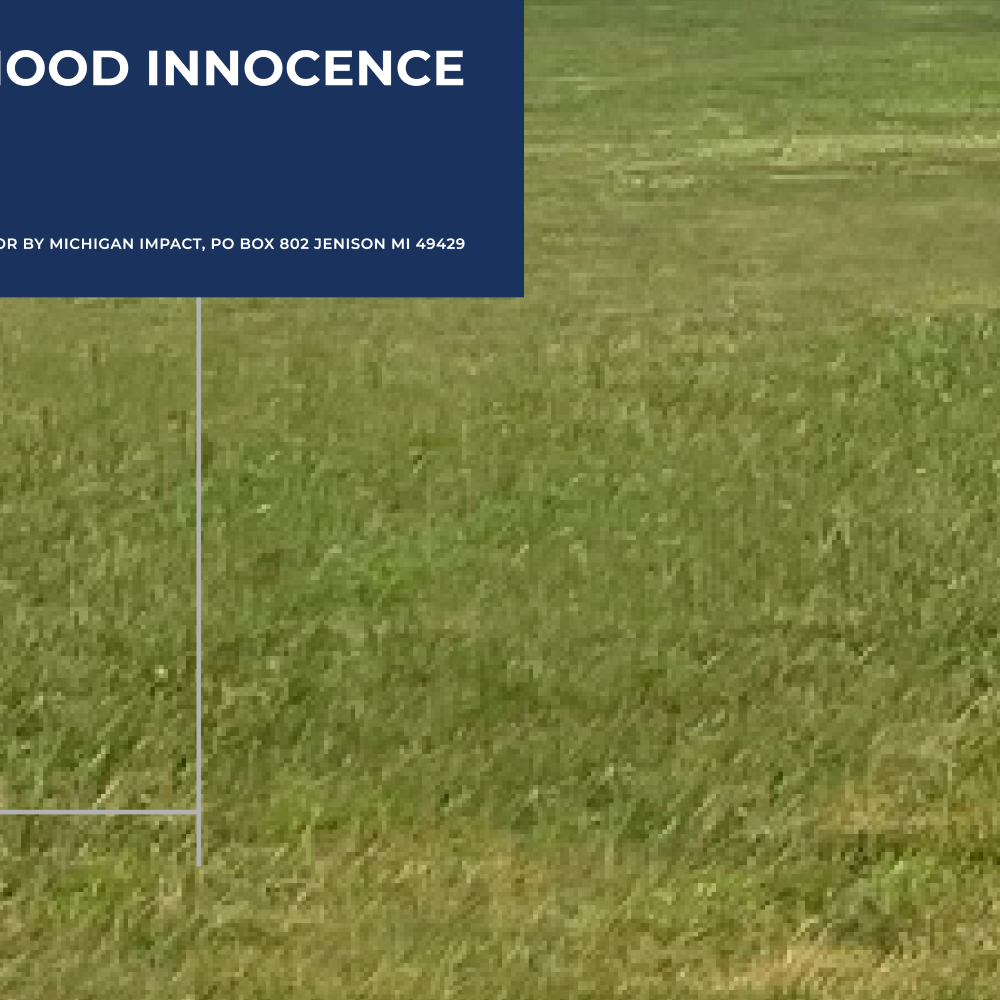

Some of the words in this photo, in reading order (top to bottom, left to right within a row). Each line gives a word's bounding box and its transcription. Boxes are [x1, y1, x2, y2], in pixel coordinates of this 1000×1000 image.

[149, 50, 463, 86] INNOCENCE
[23, 237, 45, 250] BY
[50, 237, 133, 250] MICHIGAN
[141, 237, 206, 252] IMPACT,
[211, 237, 234, 250] PO
[240, 237, 275, 250] BOX
[279, 237, 310, 250] 802
[313, 237, 385, 250] JENISON
[391, 237, 410, 250] MI
[415, 237, 466, 250] 49429
